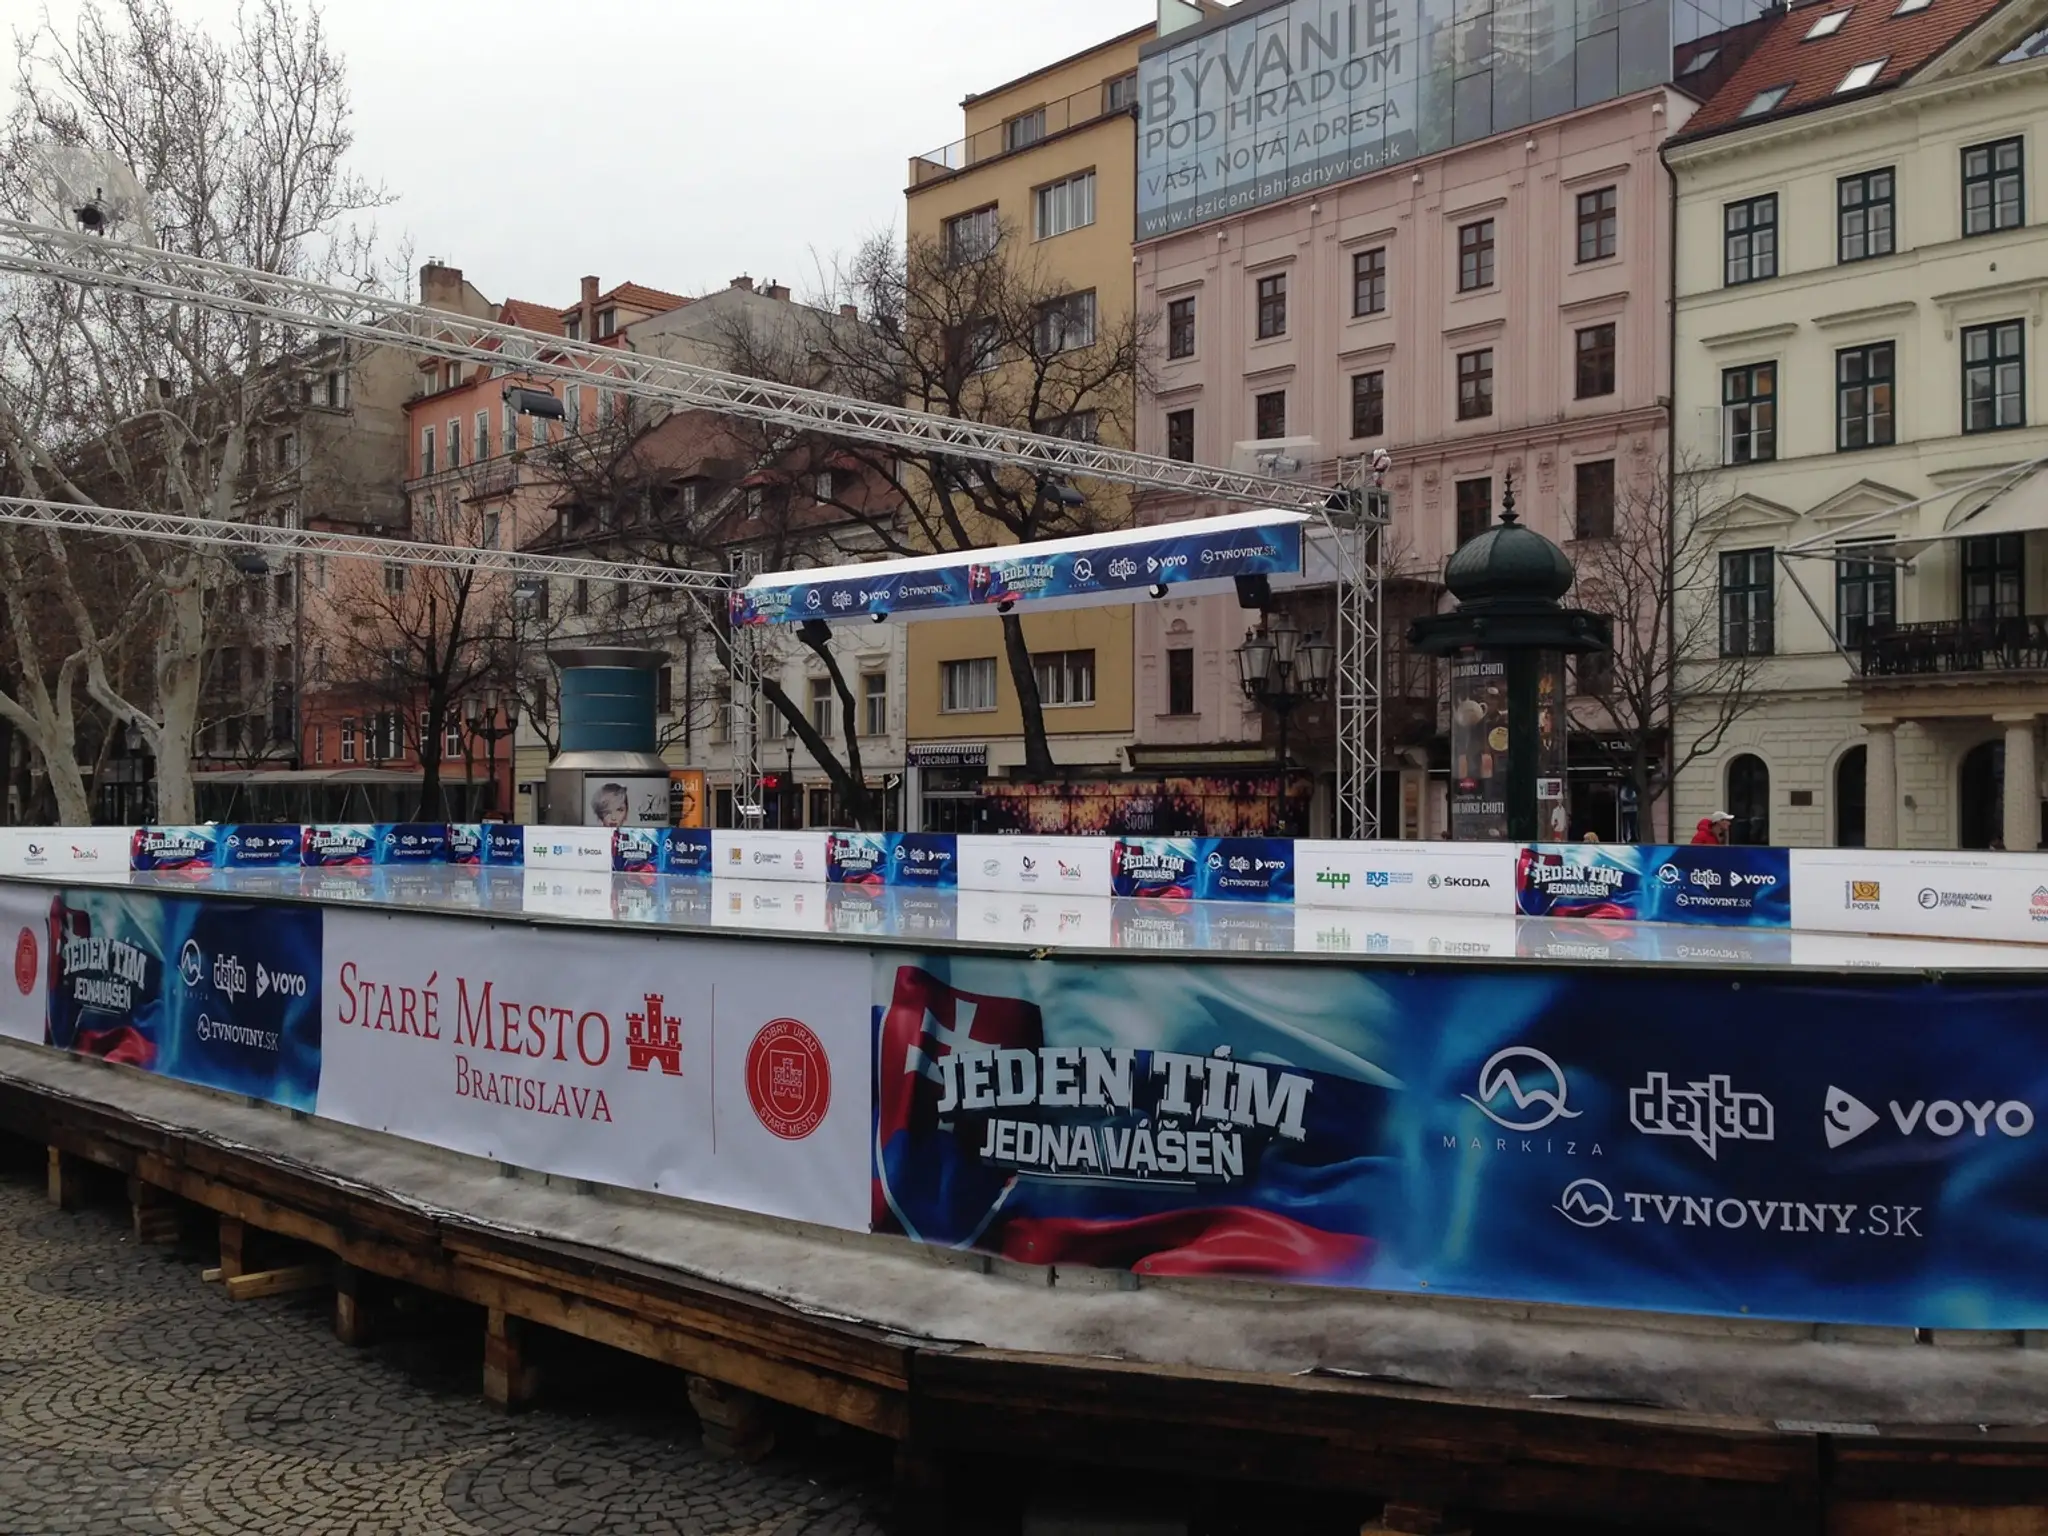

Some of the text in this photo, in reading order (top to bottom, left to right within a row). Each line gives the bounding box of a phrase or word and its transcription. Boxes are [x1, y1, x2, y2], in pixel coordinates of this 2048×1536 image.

[1147, 44, 1400, 158] POD HRADOM
[1147, 99, 1400, 196] VAŠA NOVÁ ADRESA
[1145, 143, 1400, 231] www.rezidenciahradnyvrch.sk
[1160, 554, 1188, 568] VOYO
[1214, 546, 1277, 561] TVNOVINY.SK
[999, 565, 1031, 584] JEDEN
[869, 590, 891, 600] VOYO
[1123, 854, 1159, 870] JEDEN
[1264, 861, 1286, 869] VOYO
[1533, 865, 1585, 884] JEDEN
[1316, 866, 1350, 890] zipp
[1366, 872, 1389, 888] BVS
[1444, 876, 1491, 888] ŠKODA
[1744, 875, 1777, 885] VOYO
[1689, 896, 1752, 908] TVNOVINY.SK
[63, 936, 110, 976] JEDEN
[112, 937, 147, 990] TÍM
[74, 977, 100, 1004] JEDNA
[214, 954, 247, 1004] dajto
[270, 971, 307, 997] VOYO
[339, 961, 611, 1067] STARÉ MESTO
[211, 1021, 279, 1052] TVNOVINY.SK
[455, 1054, 613, 1123] BRATISLAVA
[937, 1044, 1314, 1142] JEDEN TÍM
[790, 1111, 818, 1135] MESTO
[1629, 1071, 1775, 1162] dajto
[1889, 1099, 2035, 1137] VOYO
[980, 1118, 1245, 1183] JEDNA VÁŠEŇ
[1443, 1135, 1603, 1156] MARKÍZA
[1624, 1192, 1923, 1238] TVNOVINY.SK
